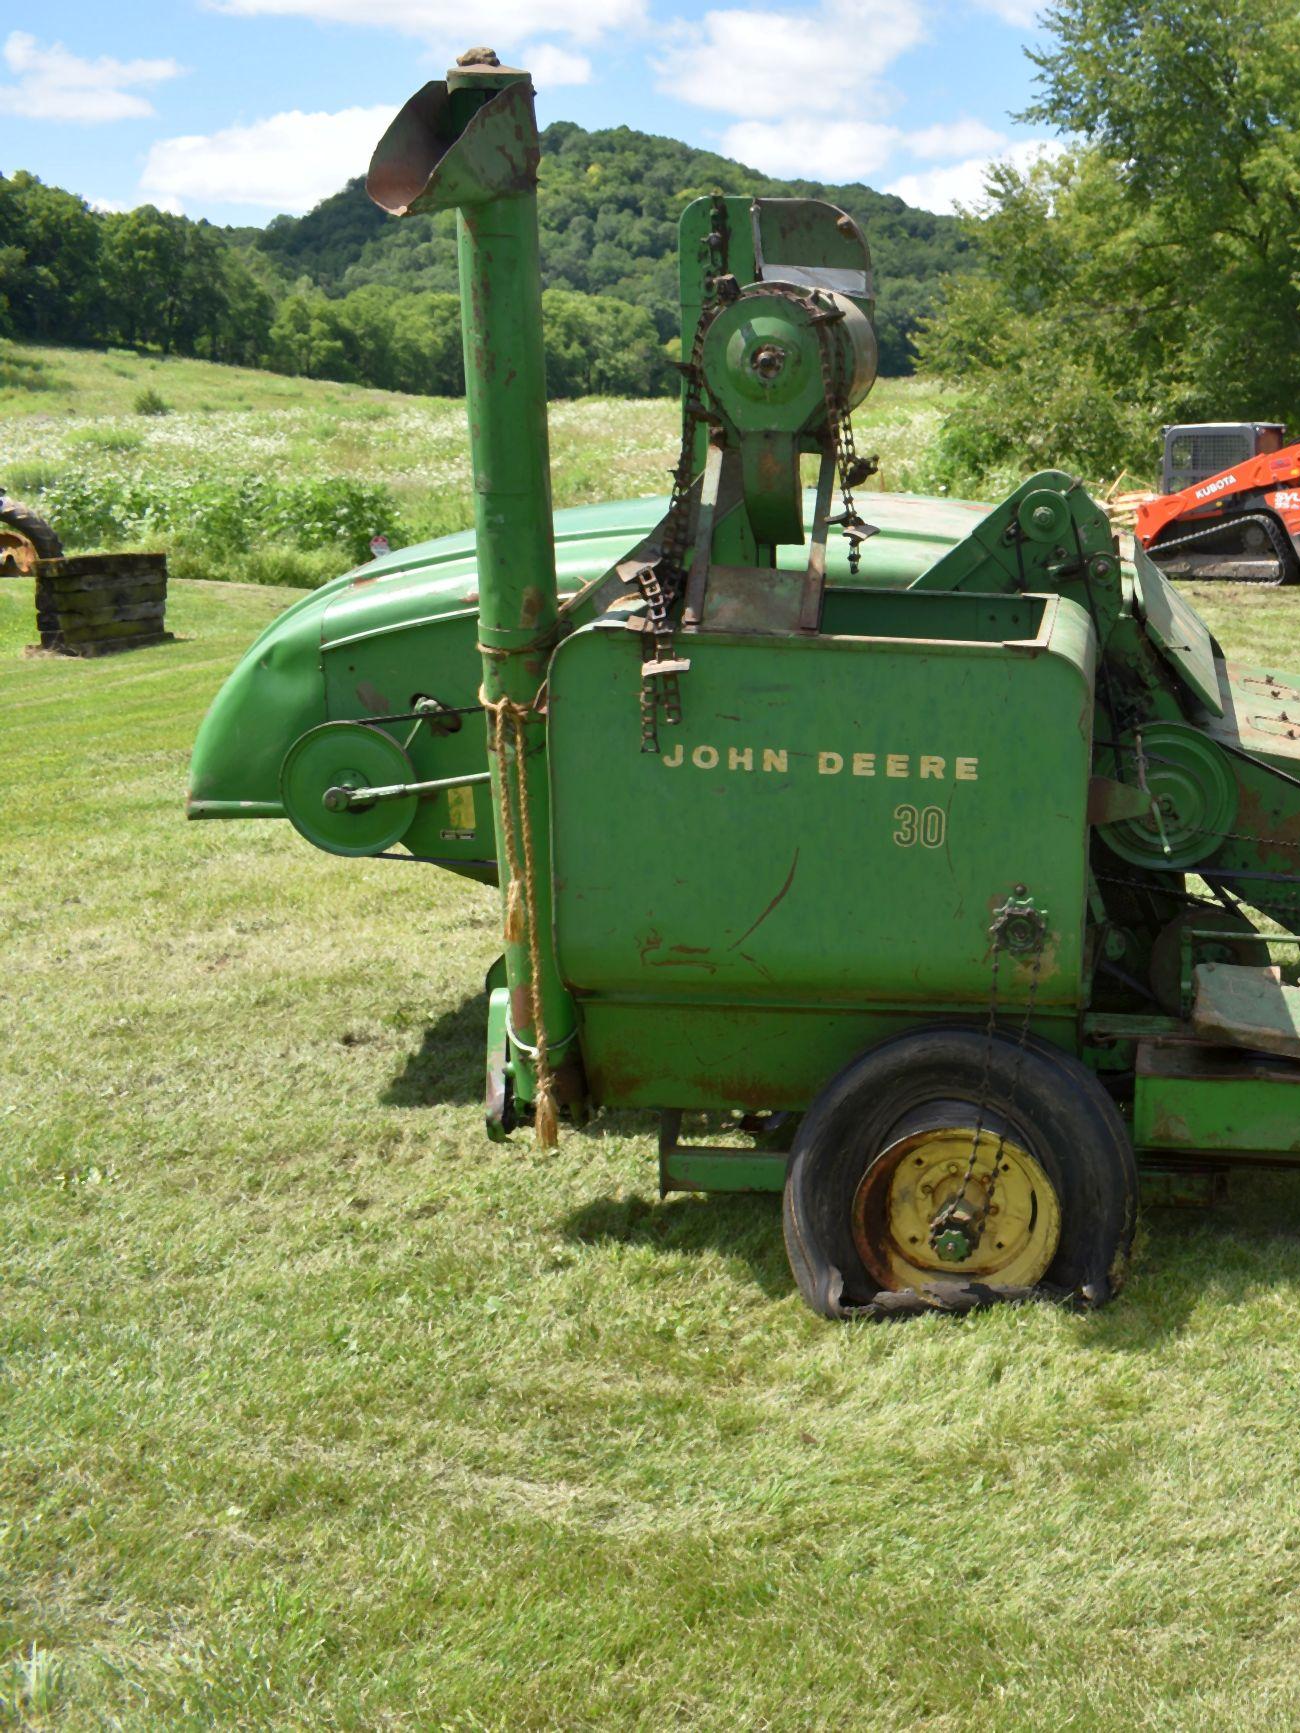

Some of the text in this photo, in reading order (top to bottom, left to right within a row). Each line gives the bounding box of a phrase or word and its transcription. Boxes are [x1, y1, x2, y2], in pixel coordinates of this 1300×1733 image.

[1195, 475, 1237, 499] KUBOTA
[663, 744, 979, 780] JOHN DEERE
[893, 804, 945, 848] 30
